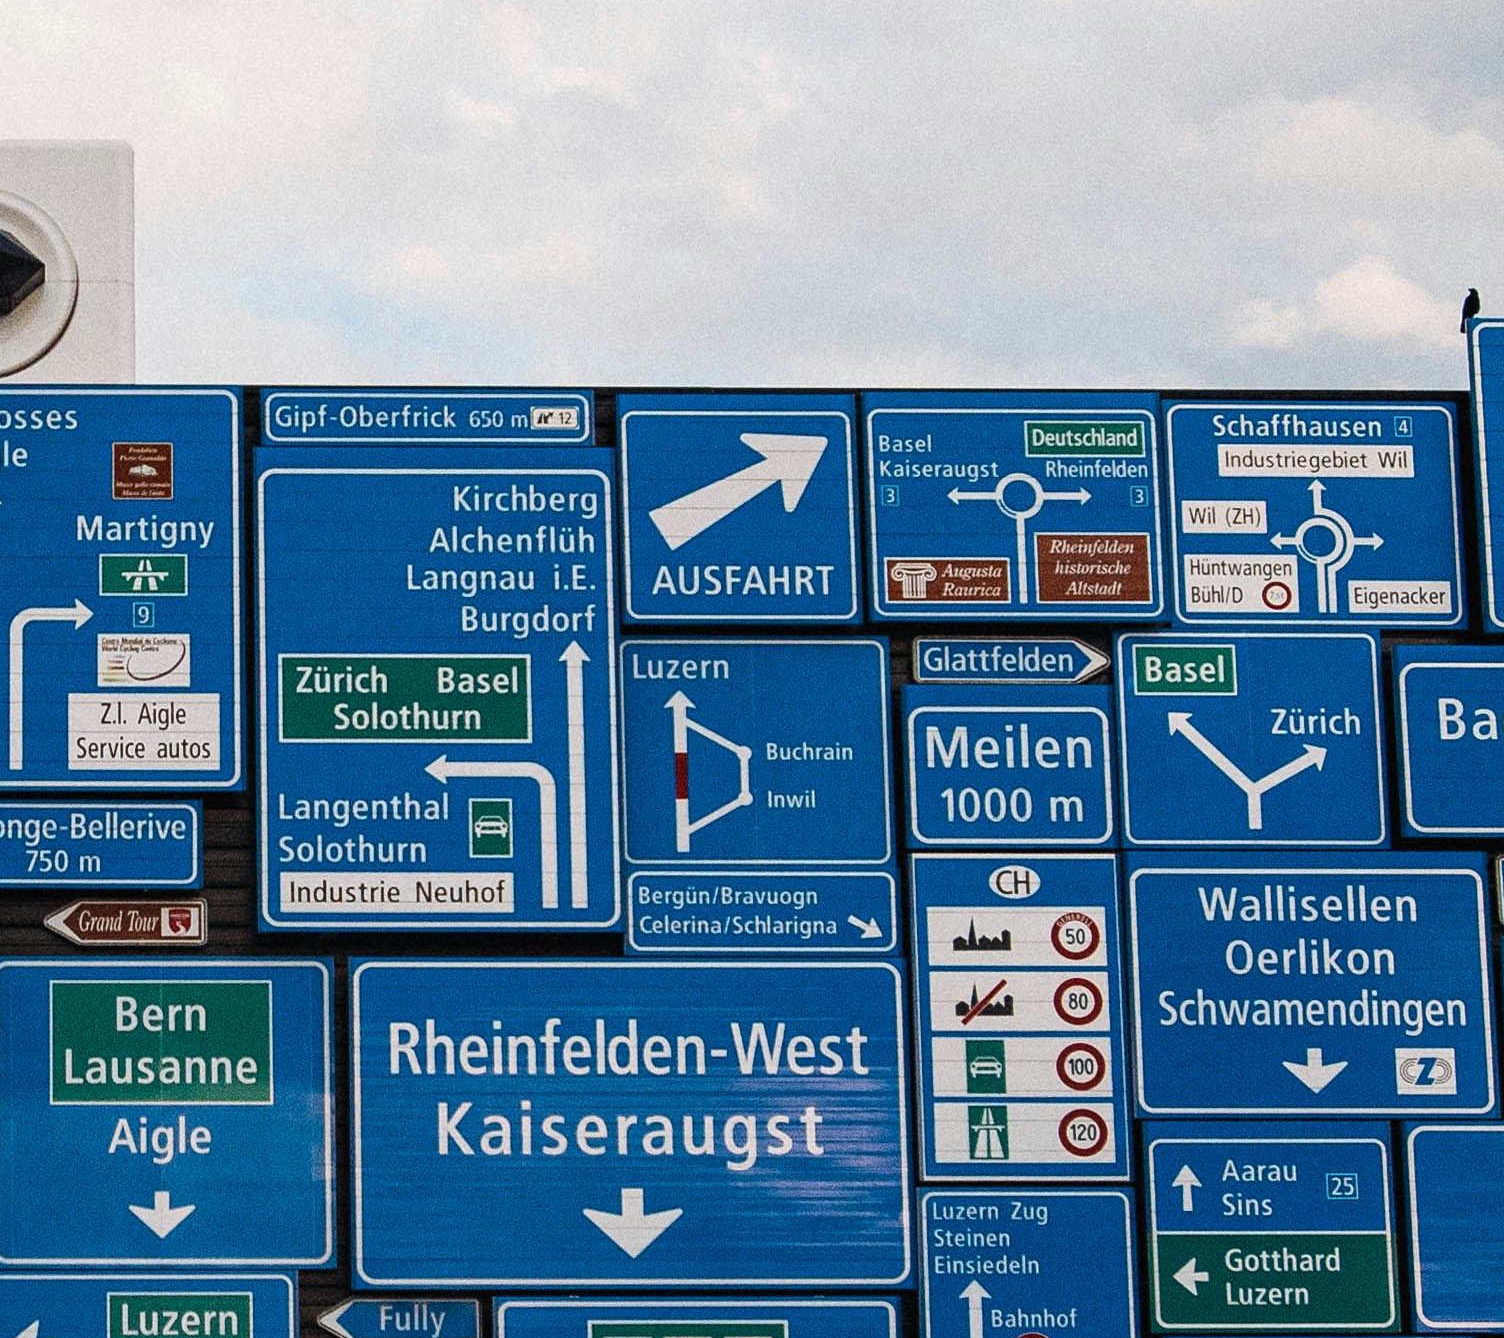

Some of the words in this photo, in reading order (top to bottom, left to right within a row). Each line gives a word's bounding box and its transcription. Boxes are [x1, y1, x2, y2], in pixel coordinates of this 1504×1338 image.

[275, 403, 457, 434] Gipf-Oberfrick
[469, 409, 504, 430] 650
[510, 414, 529, 428] m
[558, 411, 572, 424] 12
[878, 434, 932, 453] Basel
[1224, 449, 1368, 474] Industriegebiet
[1377, 450, 1408, 469] Wil
[76, 514, 215, 549] Martigny
[1049, 538, 1135, 557] Rheinfelden
[407, 564, 535, 598] Langnau
[554, 563, 596, 591] i.E.
[652, 565, 835, 595] AUSFAHRT
[1189, 558, 1293, 582] Hüntwangen
[1353, 586, 1446, 610] Eigenacker
[923, 645, 1074, 673] Glattfelden
[296, 664, 388, 694] Zürich
[437, 665, 519, 694] Basel
[1270, 707, 1361, 735] Zürich
[76, 735, 146, 759] Service
[156, 738, 211, 759] autos
[767, 789, 816, 808] Inwil
[940, 787, 1033, 823] 1000
[1049, 796, 1084, 822] m
[290, 879, 401, 903] Industrie
[415, 879, 506, 904] Neuhof
[1198, 884, 1417, 922] Wallisellen
[389, 1017, 870, 1076] Rheinfelden-West
[65, 1048, 258, 1085] Lausanne
[1068, 1057, 1095, 1076] 100
[933, 1228, 1011, 1248] Steinen
[1224, 1246, 1341, 1272] Gotthard
[380, 1304, 445, 1338] Fully
